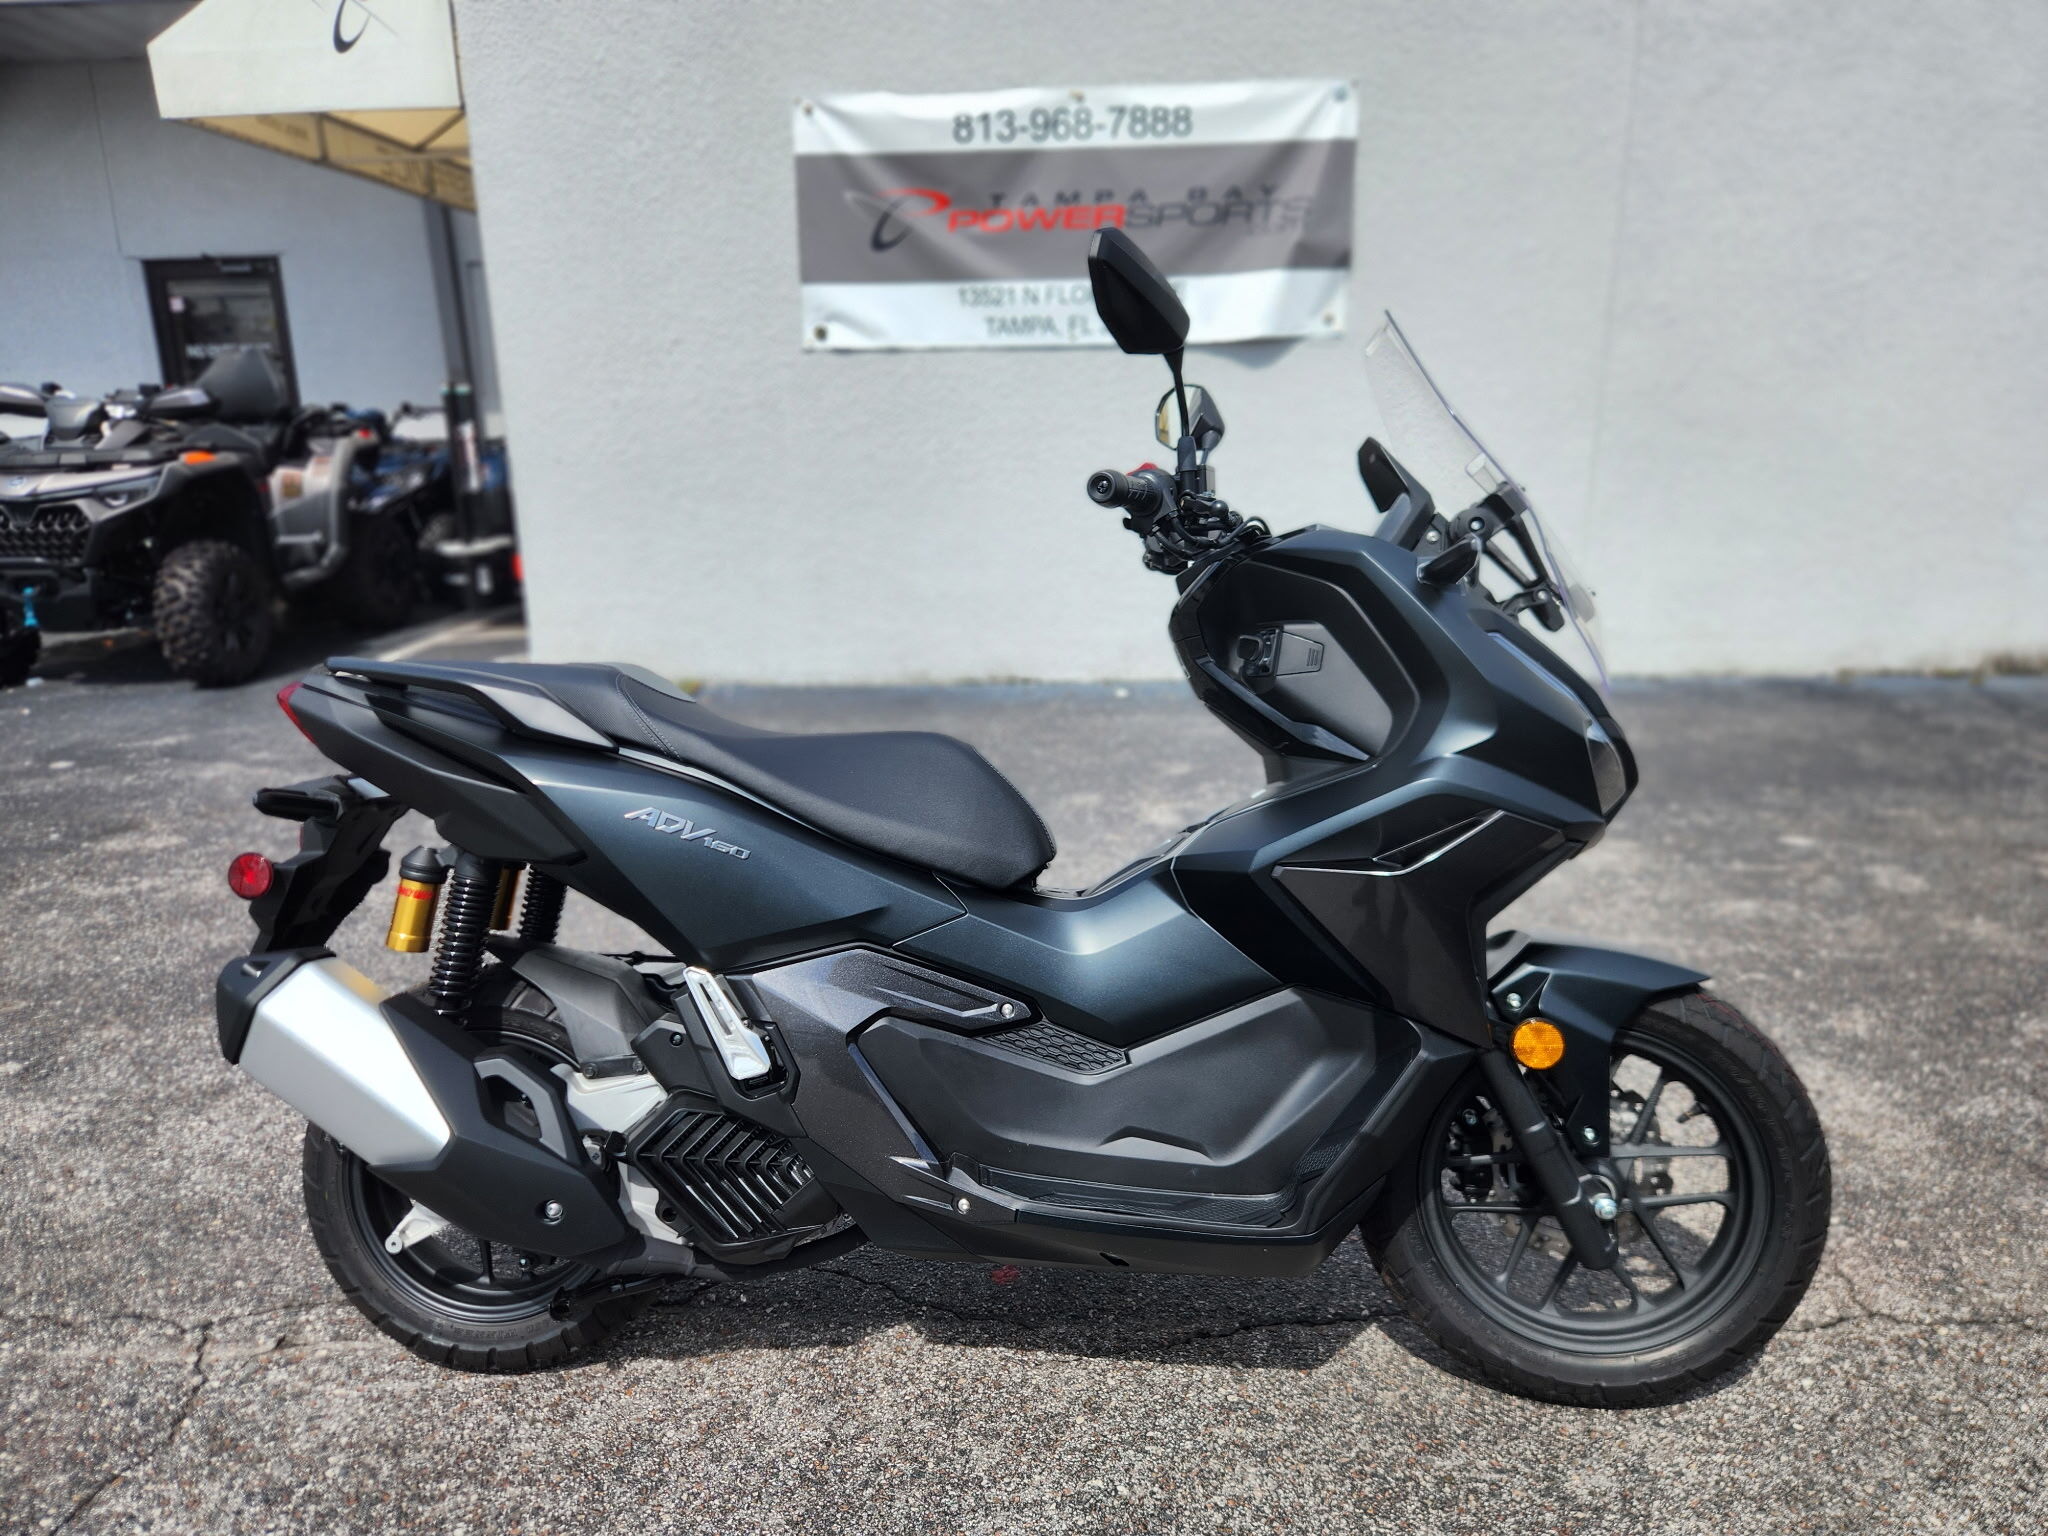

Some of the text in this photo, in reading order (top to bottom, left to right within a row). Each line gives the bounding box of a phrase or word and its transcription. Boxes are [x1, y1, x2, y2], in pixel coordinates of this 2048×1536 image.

[952, 104, 1194, 145] 813-968-7888
[988, 184, 1277, 208] TAMPA BAY
[947, 199, 1312, 234] POWERSPORTS
[1022, 285, 1039, 305] N
[1044, 284, 1094, 305] FLO
